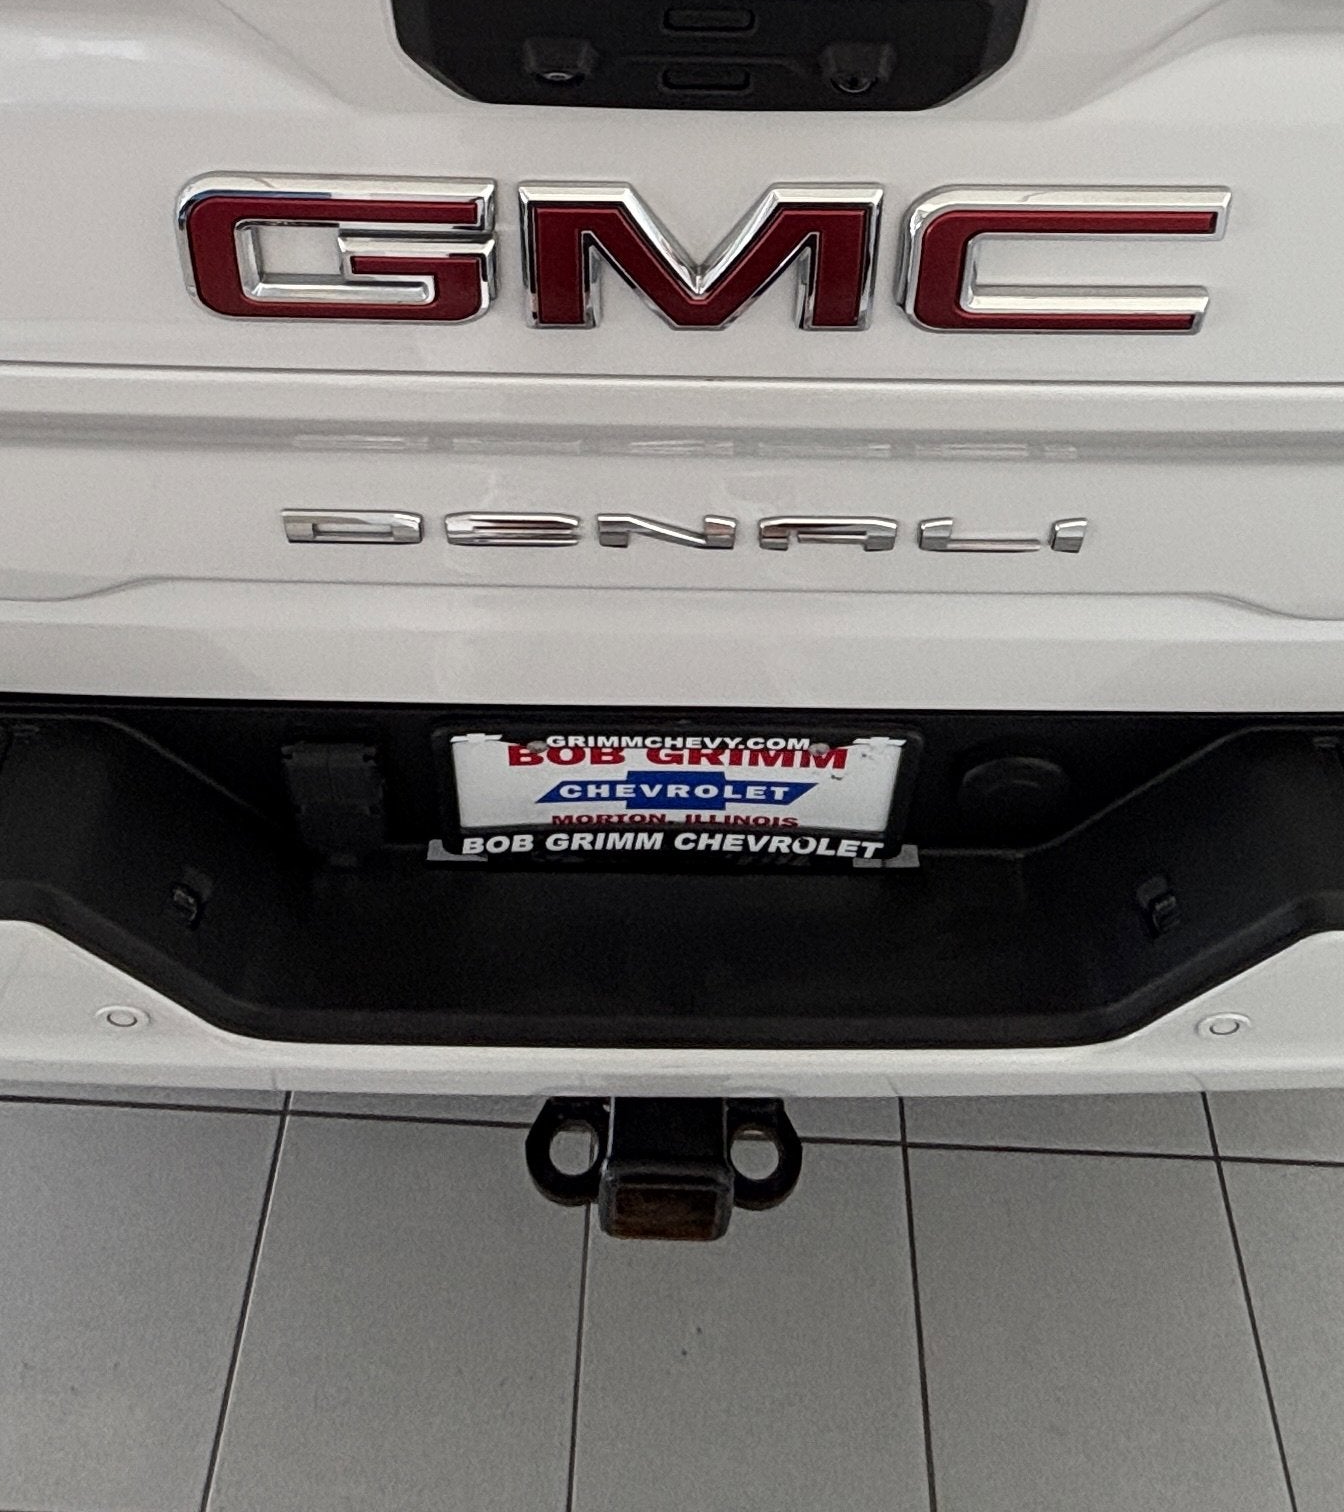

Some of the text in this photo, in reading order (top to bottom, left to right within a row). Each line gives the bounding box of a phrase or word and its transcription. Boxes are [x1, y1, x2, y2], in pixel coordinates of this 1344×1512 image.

[177, 171, 1232, 335] GMC
[280, 507, 1089, 554] DENALI
[546, 735, 810, 751] GRIMMCHEVY.COM
[508, 745, 849, 770] BOB GRIMM
[558, 783, 790, 801] CHEVROLET
[685, 813, 800, 829] ILLINOIS
[462, 831, 885, 859] BOB GRIMM CHEVROLET
